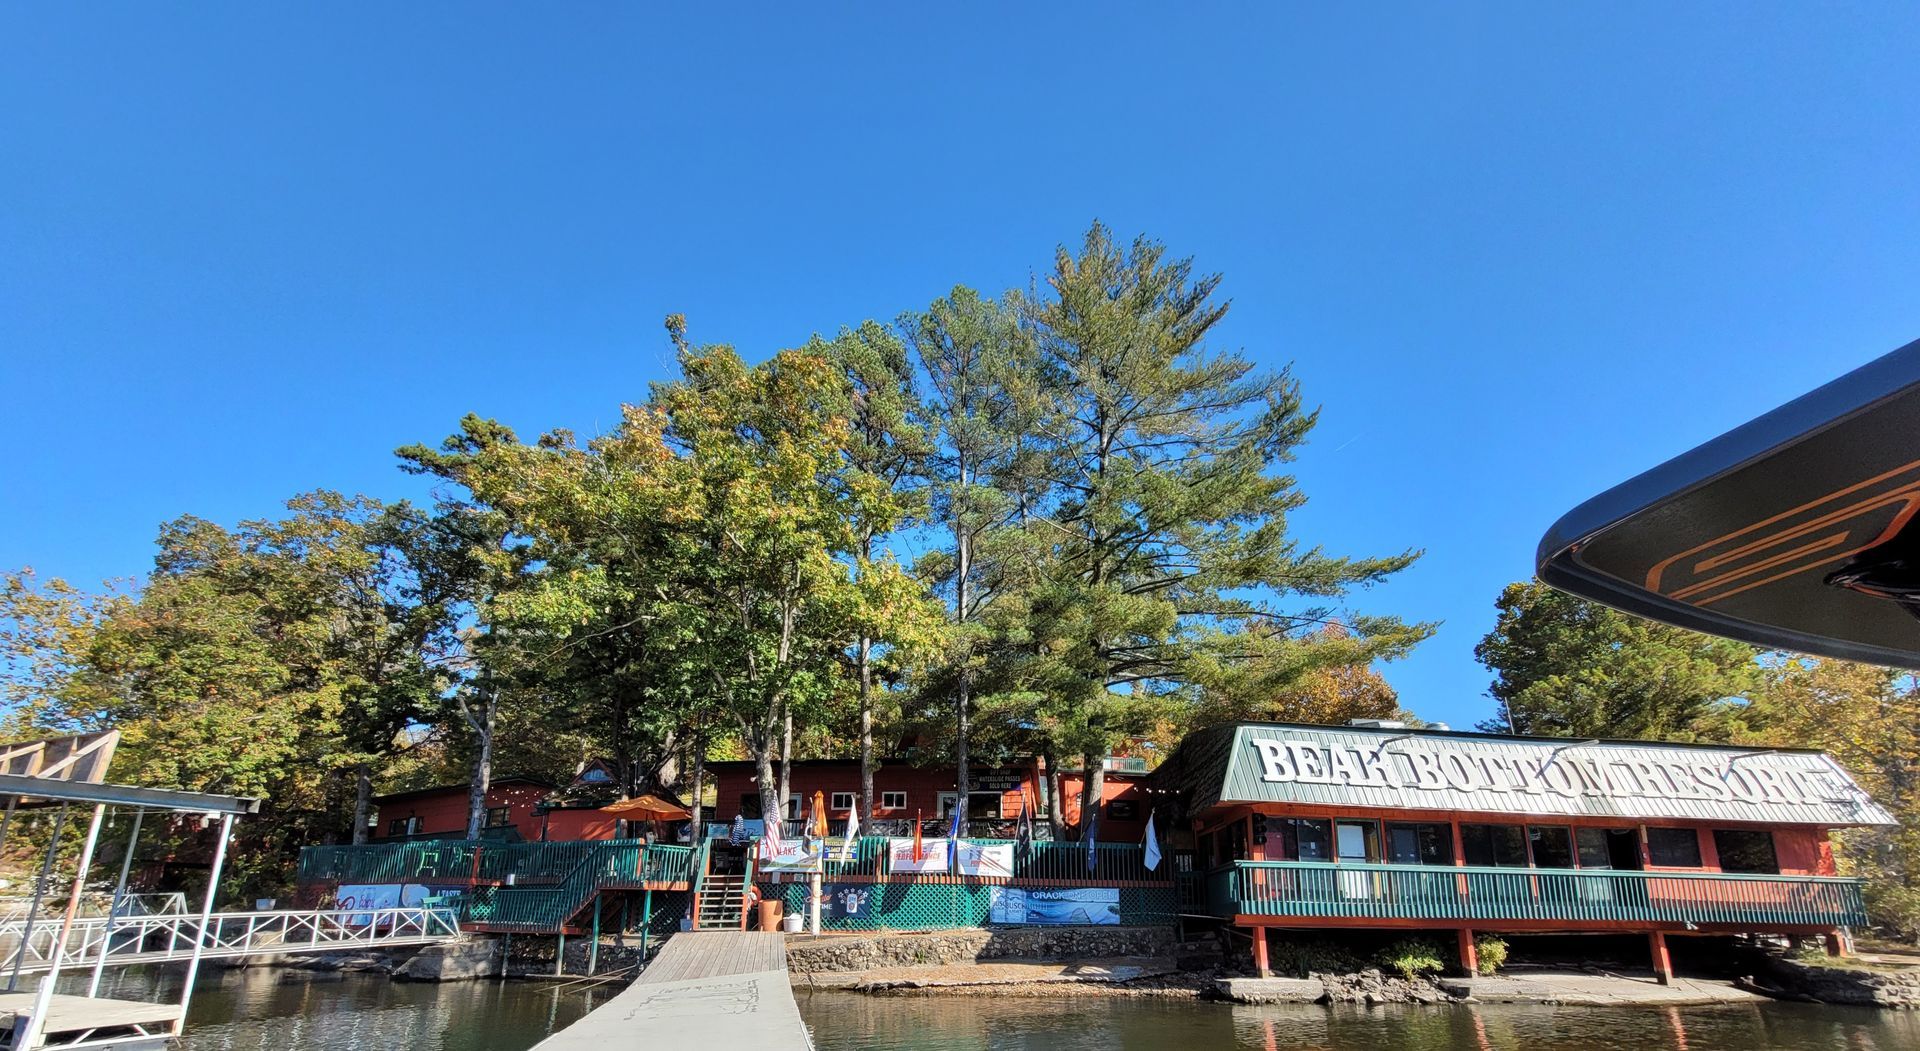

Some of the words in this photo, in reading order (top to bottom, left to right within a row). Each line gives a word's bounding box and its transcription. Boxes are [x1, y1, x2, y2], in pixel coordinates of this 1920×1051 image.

[1251, 738, 1402, 789] BEAR
[1402, 747, 1629, 800] BOTTOM
[1616, 760, 1822, 805] RESORT
[779, 846, 797, 856] LAKE
[893, 852, 941, 861] PERFOANCE
[1032, 891, 1064, 900] CRACK
[1089, 891, 1115, 900] OPEN
